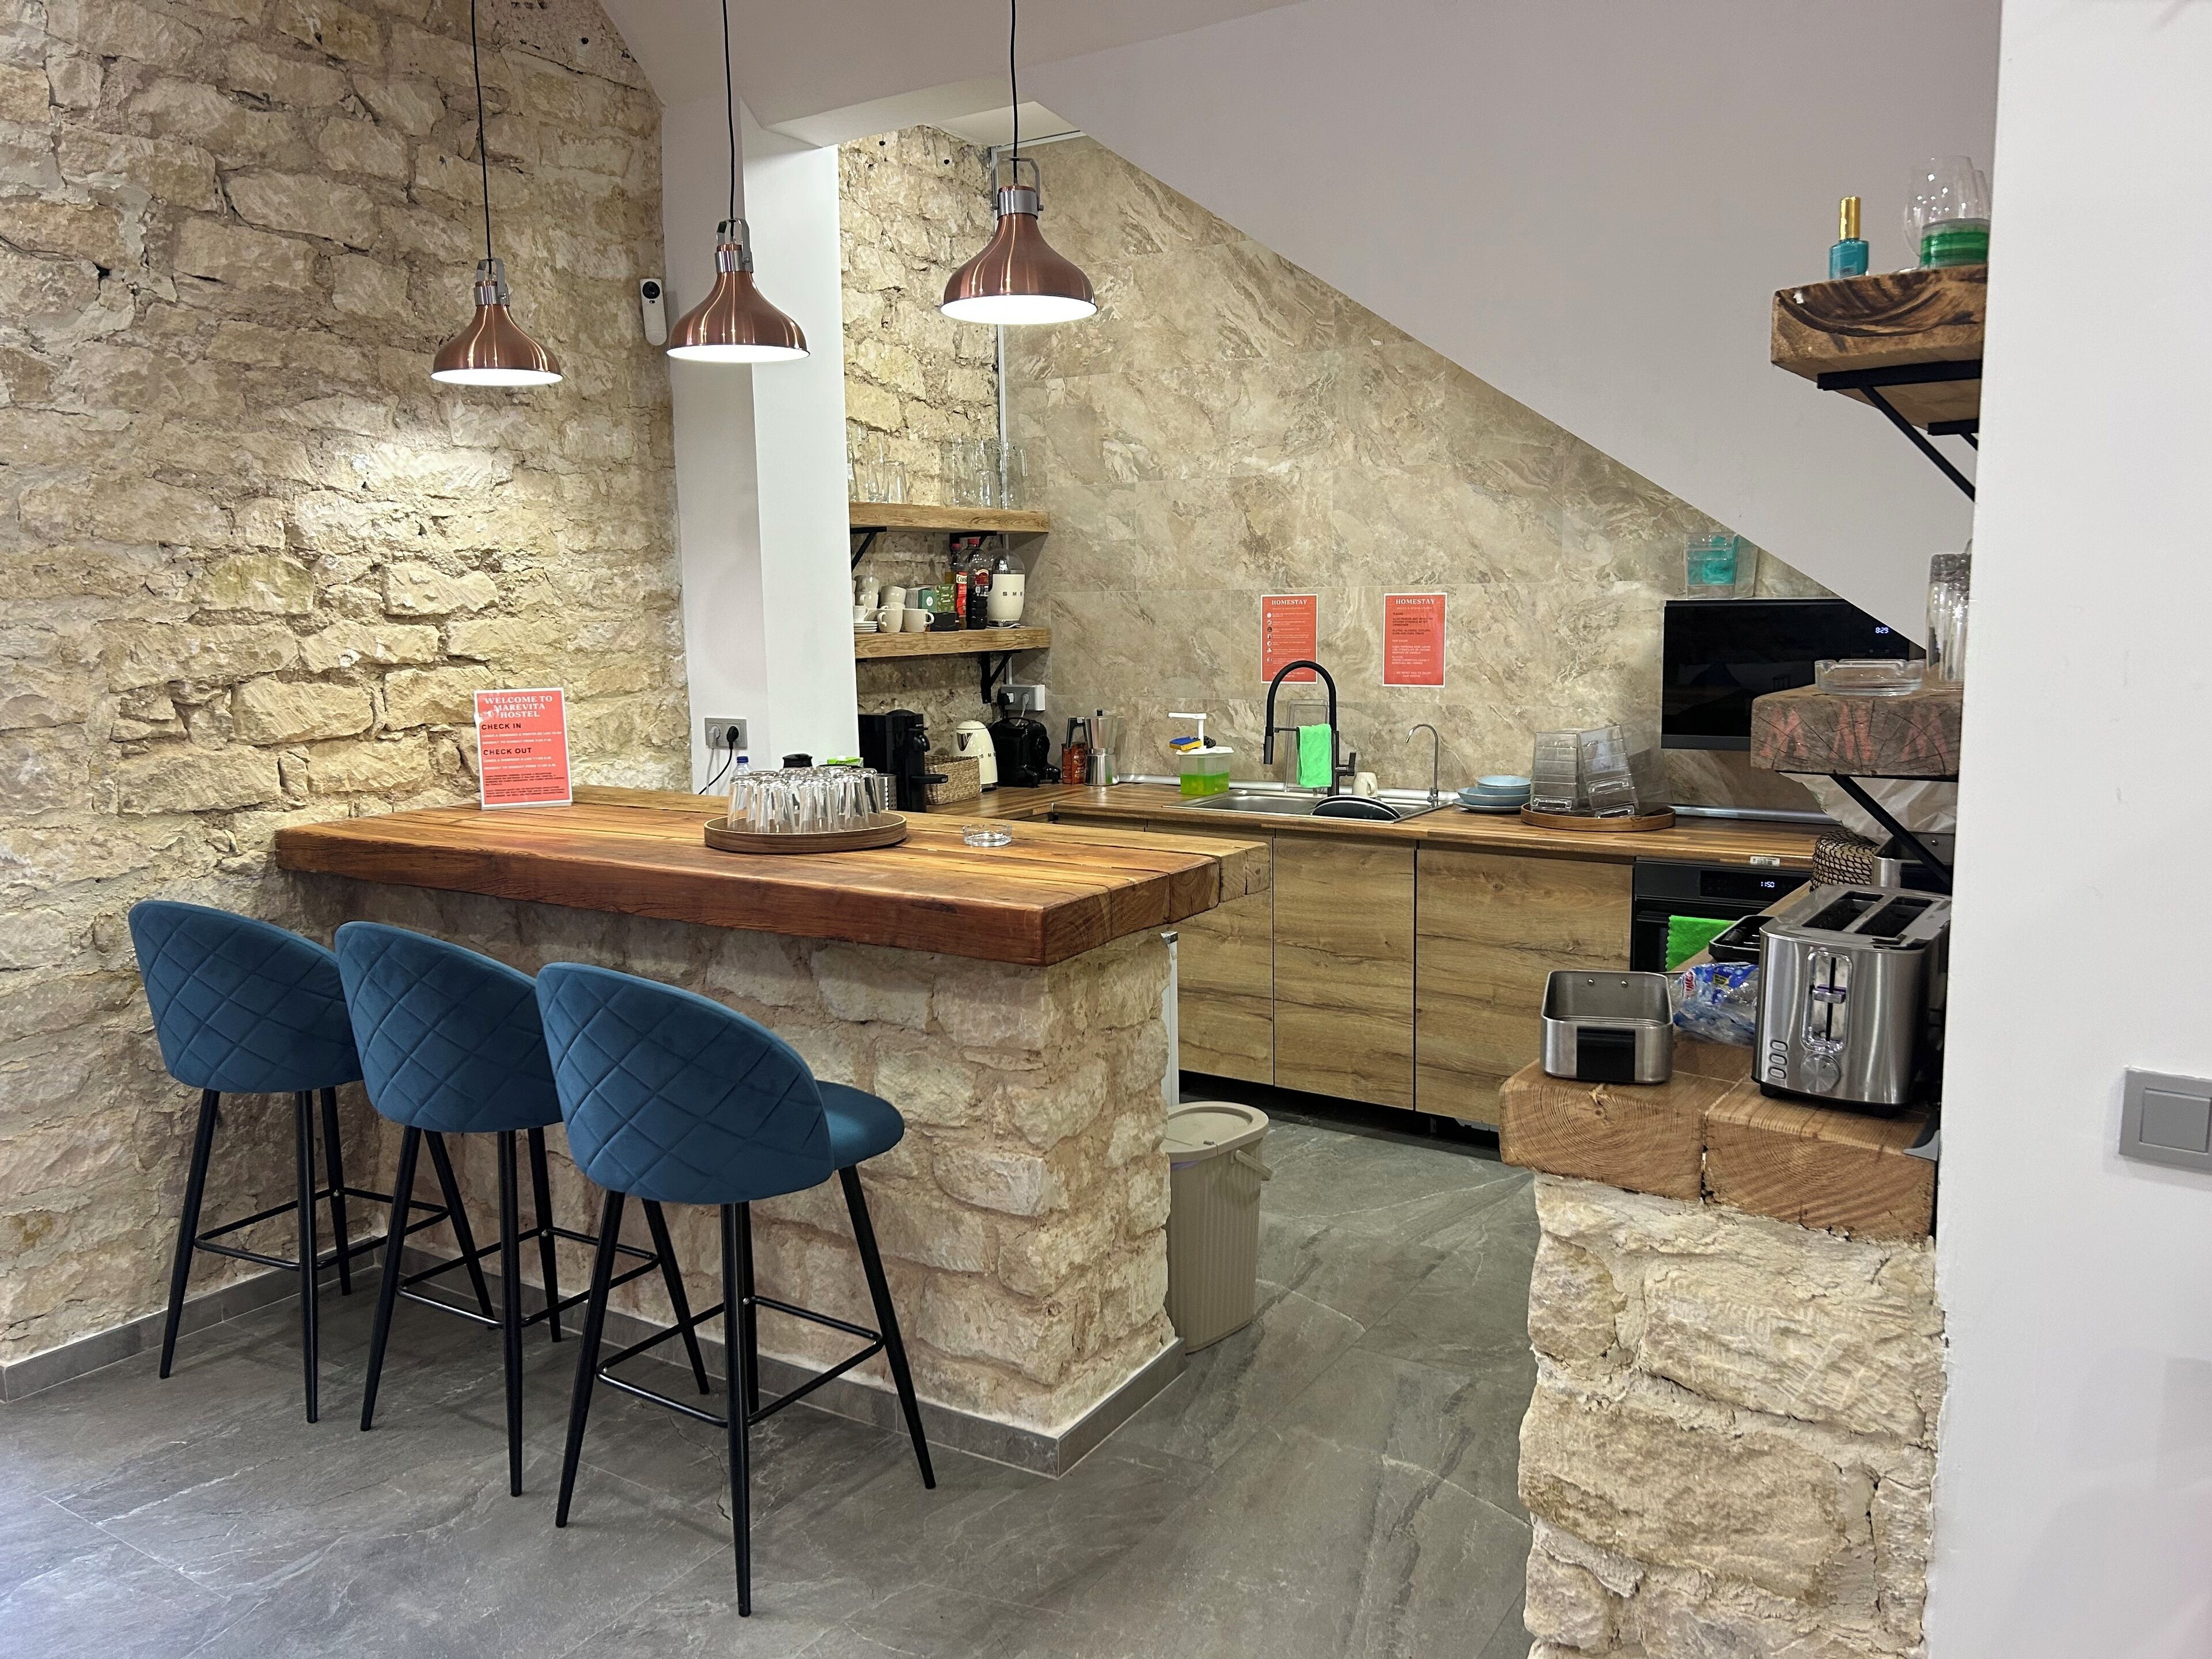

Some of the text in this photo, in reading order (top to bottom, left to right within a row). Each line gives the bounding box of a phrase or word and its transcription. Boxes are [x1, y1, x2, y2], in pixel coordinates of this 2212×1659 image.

[483, 696, 537, 704] WELCOME
[494, 703, 546, 711] MAREVITA
[500, 710, 540, 718] HOSTEL
